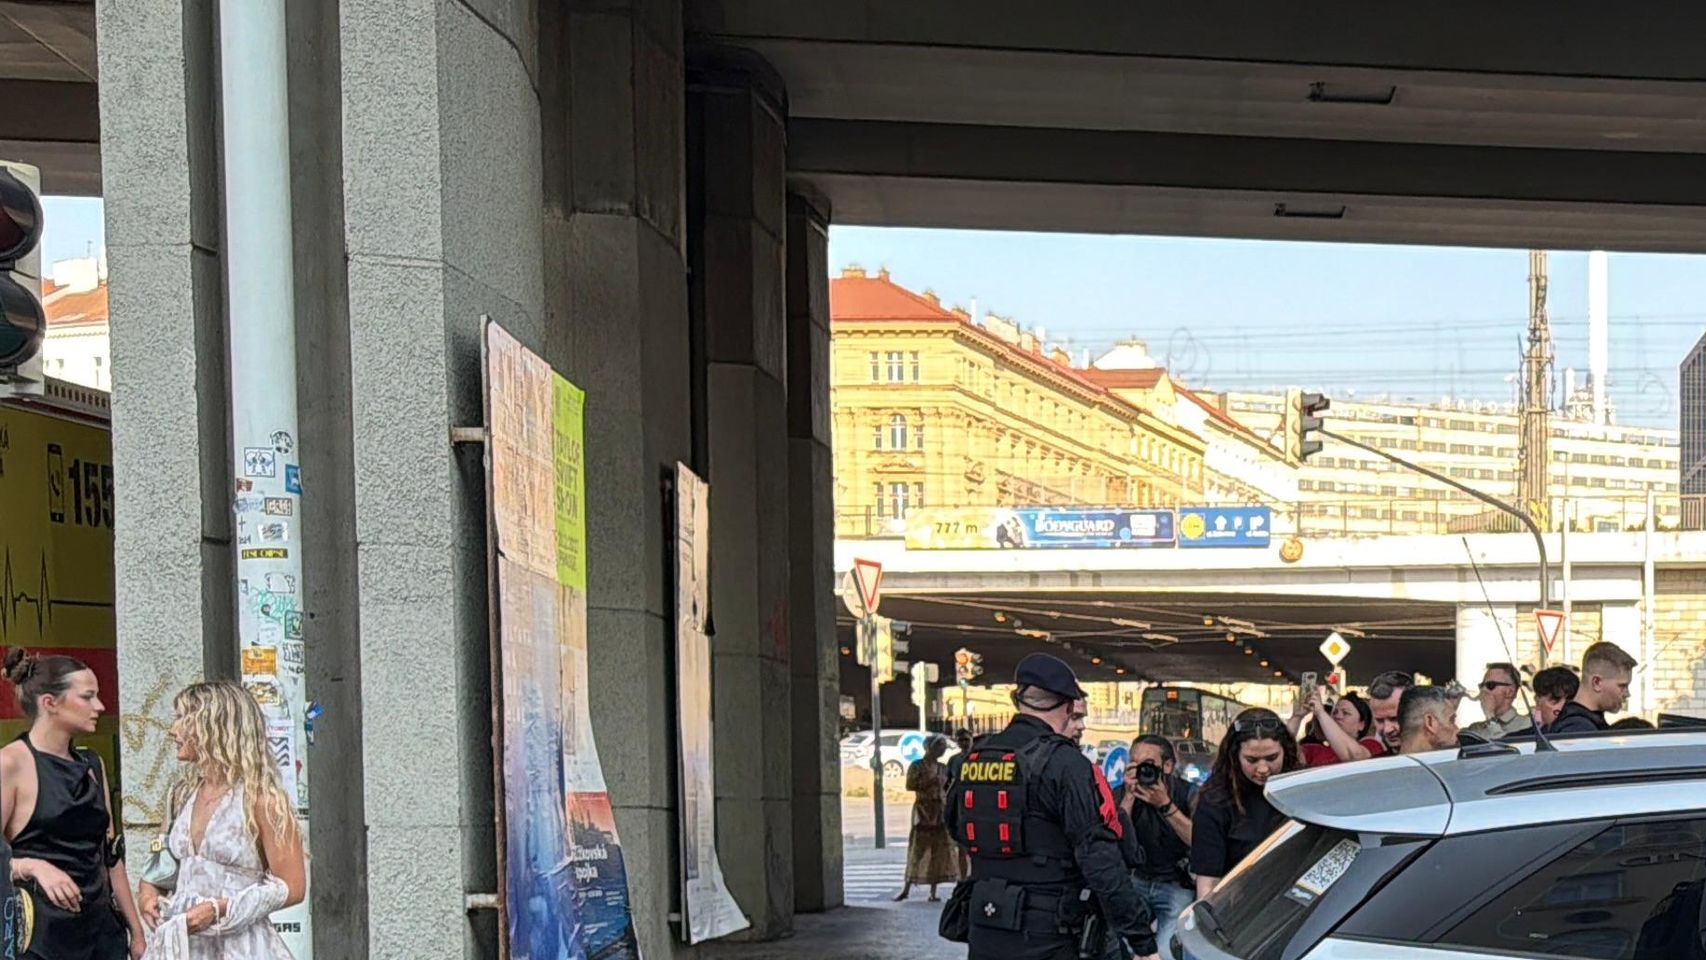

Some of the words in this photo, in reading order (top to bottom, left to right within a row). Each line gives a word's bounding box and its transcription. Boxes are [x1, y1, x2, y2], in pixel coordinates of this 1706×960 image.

[68, 458, 114, 528] 155
[936, 521, 960, 534] 777
[960, 762, 1016, 781] POLICIE
